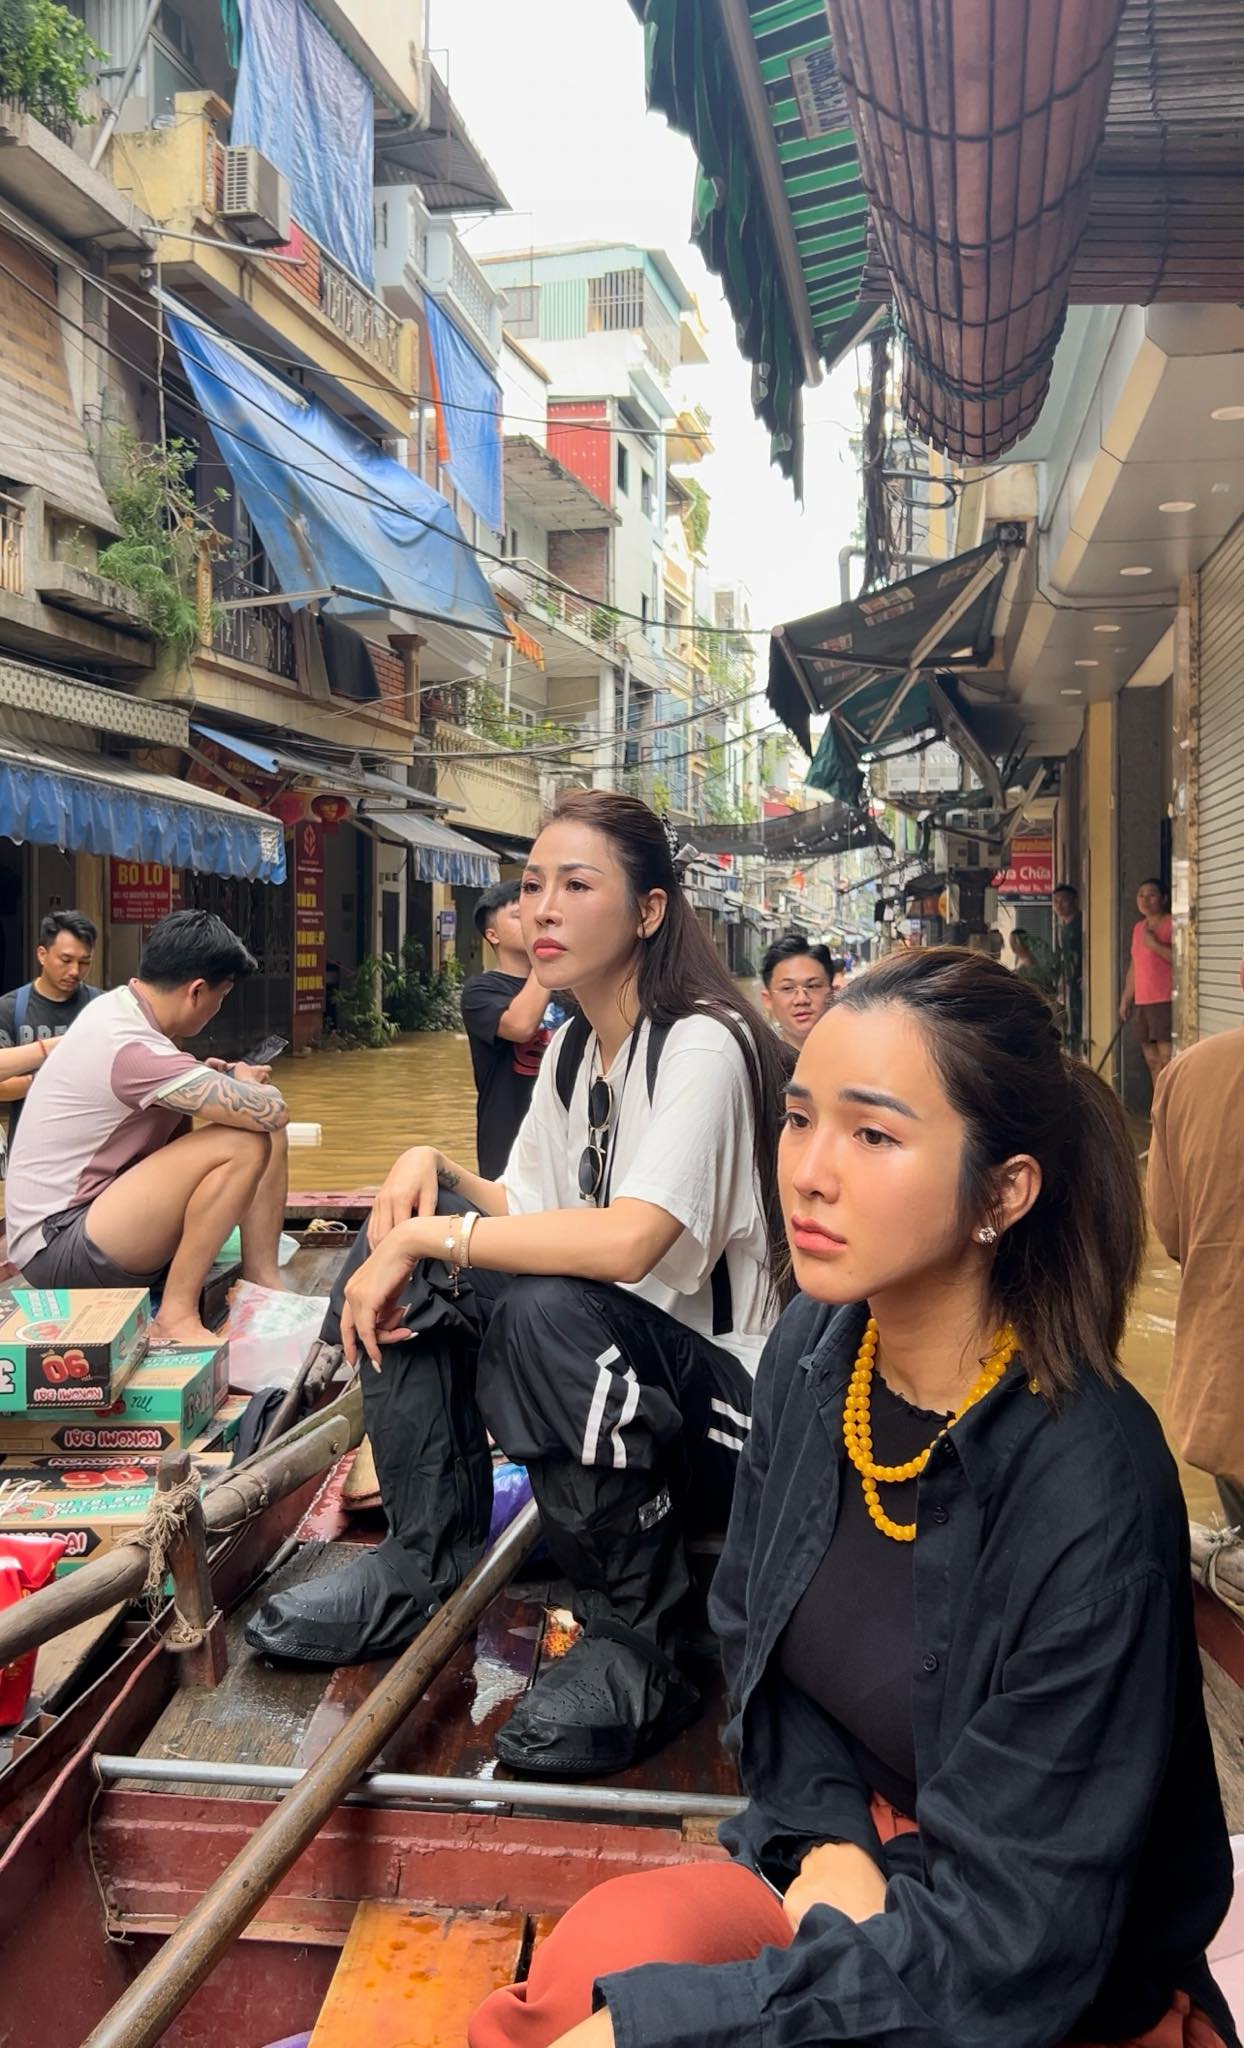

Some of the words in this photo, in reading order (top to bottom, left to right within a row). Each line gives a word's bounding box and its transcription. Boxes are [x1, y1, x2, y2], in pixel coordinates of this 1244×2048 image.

[33, 1386, 56, 1401] ĐẠI
[58, 1387, 103, 1401] KOKOMI
[64, 1429, 96, 1447] ĐẠI
[98, 1430, 162, 1447] KOKOMI
